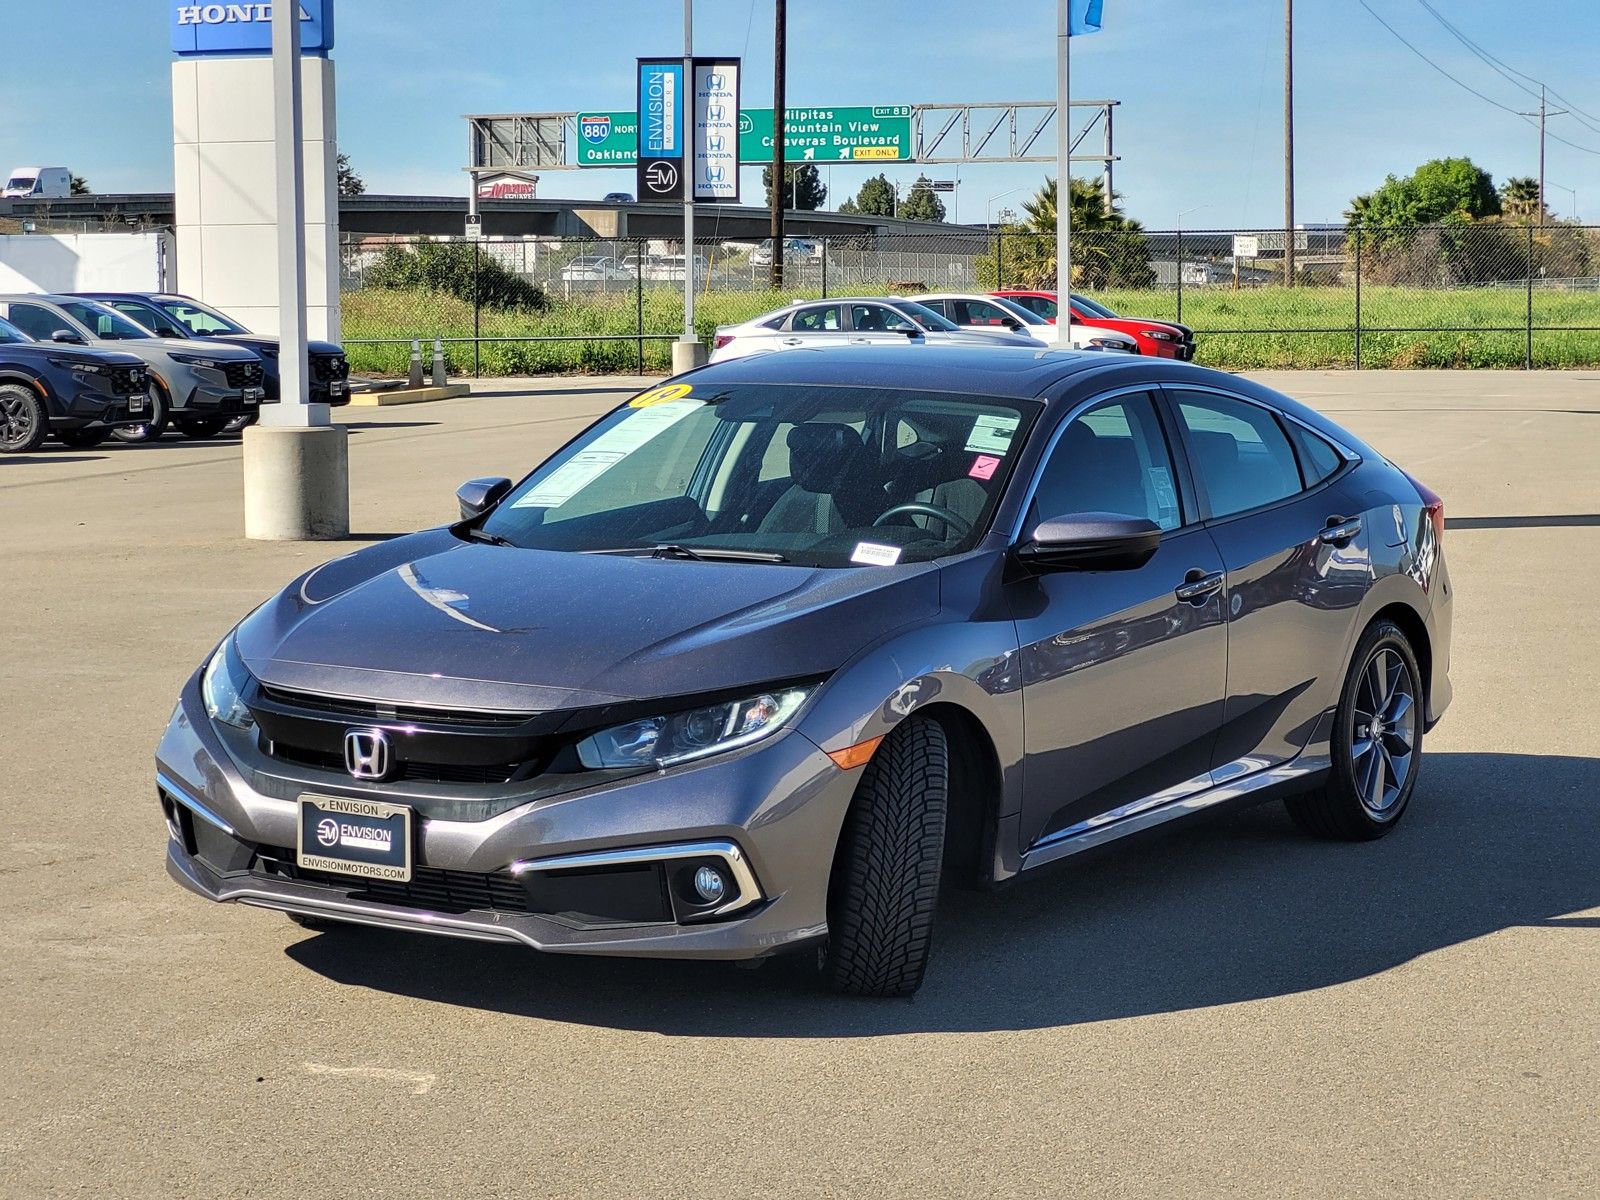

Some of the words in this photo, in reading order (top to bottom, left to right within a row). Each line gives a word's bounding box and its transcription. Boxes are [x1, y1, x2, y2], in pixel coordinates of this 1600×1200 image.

[648, 71, 663, 151] ENVISION
[665, 79, 673, 144] MOTORS
[784, 110, 834, 122] Milpitas
[585, 125, 608, 138] 880
[784, 123, 842, 133] Mountain
[849, 121, 880, 132] View
[762, 136, 826, 147] Caaveras
[833, 135, 900, 146] Boulevard
[854, 149, 872, 157] EXIT
[876, 149, 898, 157] ONLY
[329, 800, 378, 816] ENVISION
[341, 824, 392, 842] ENVISION
[302, 857, 406, 880] ENVISIONMOTORS.COM
